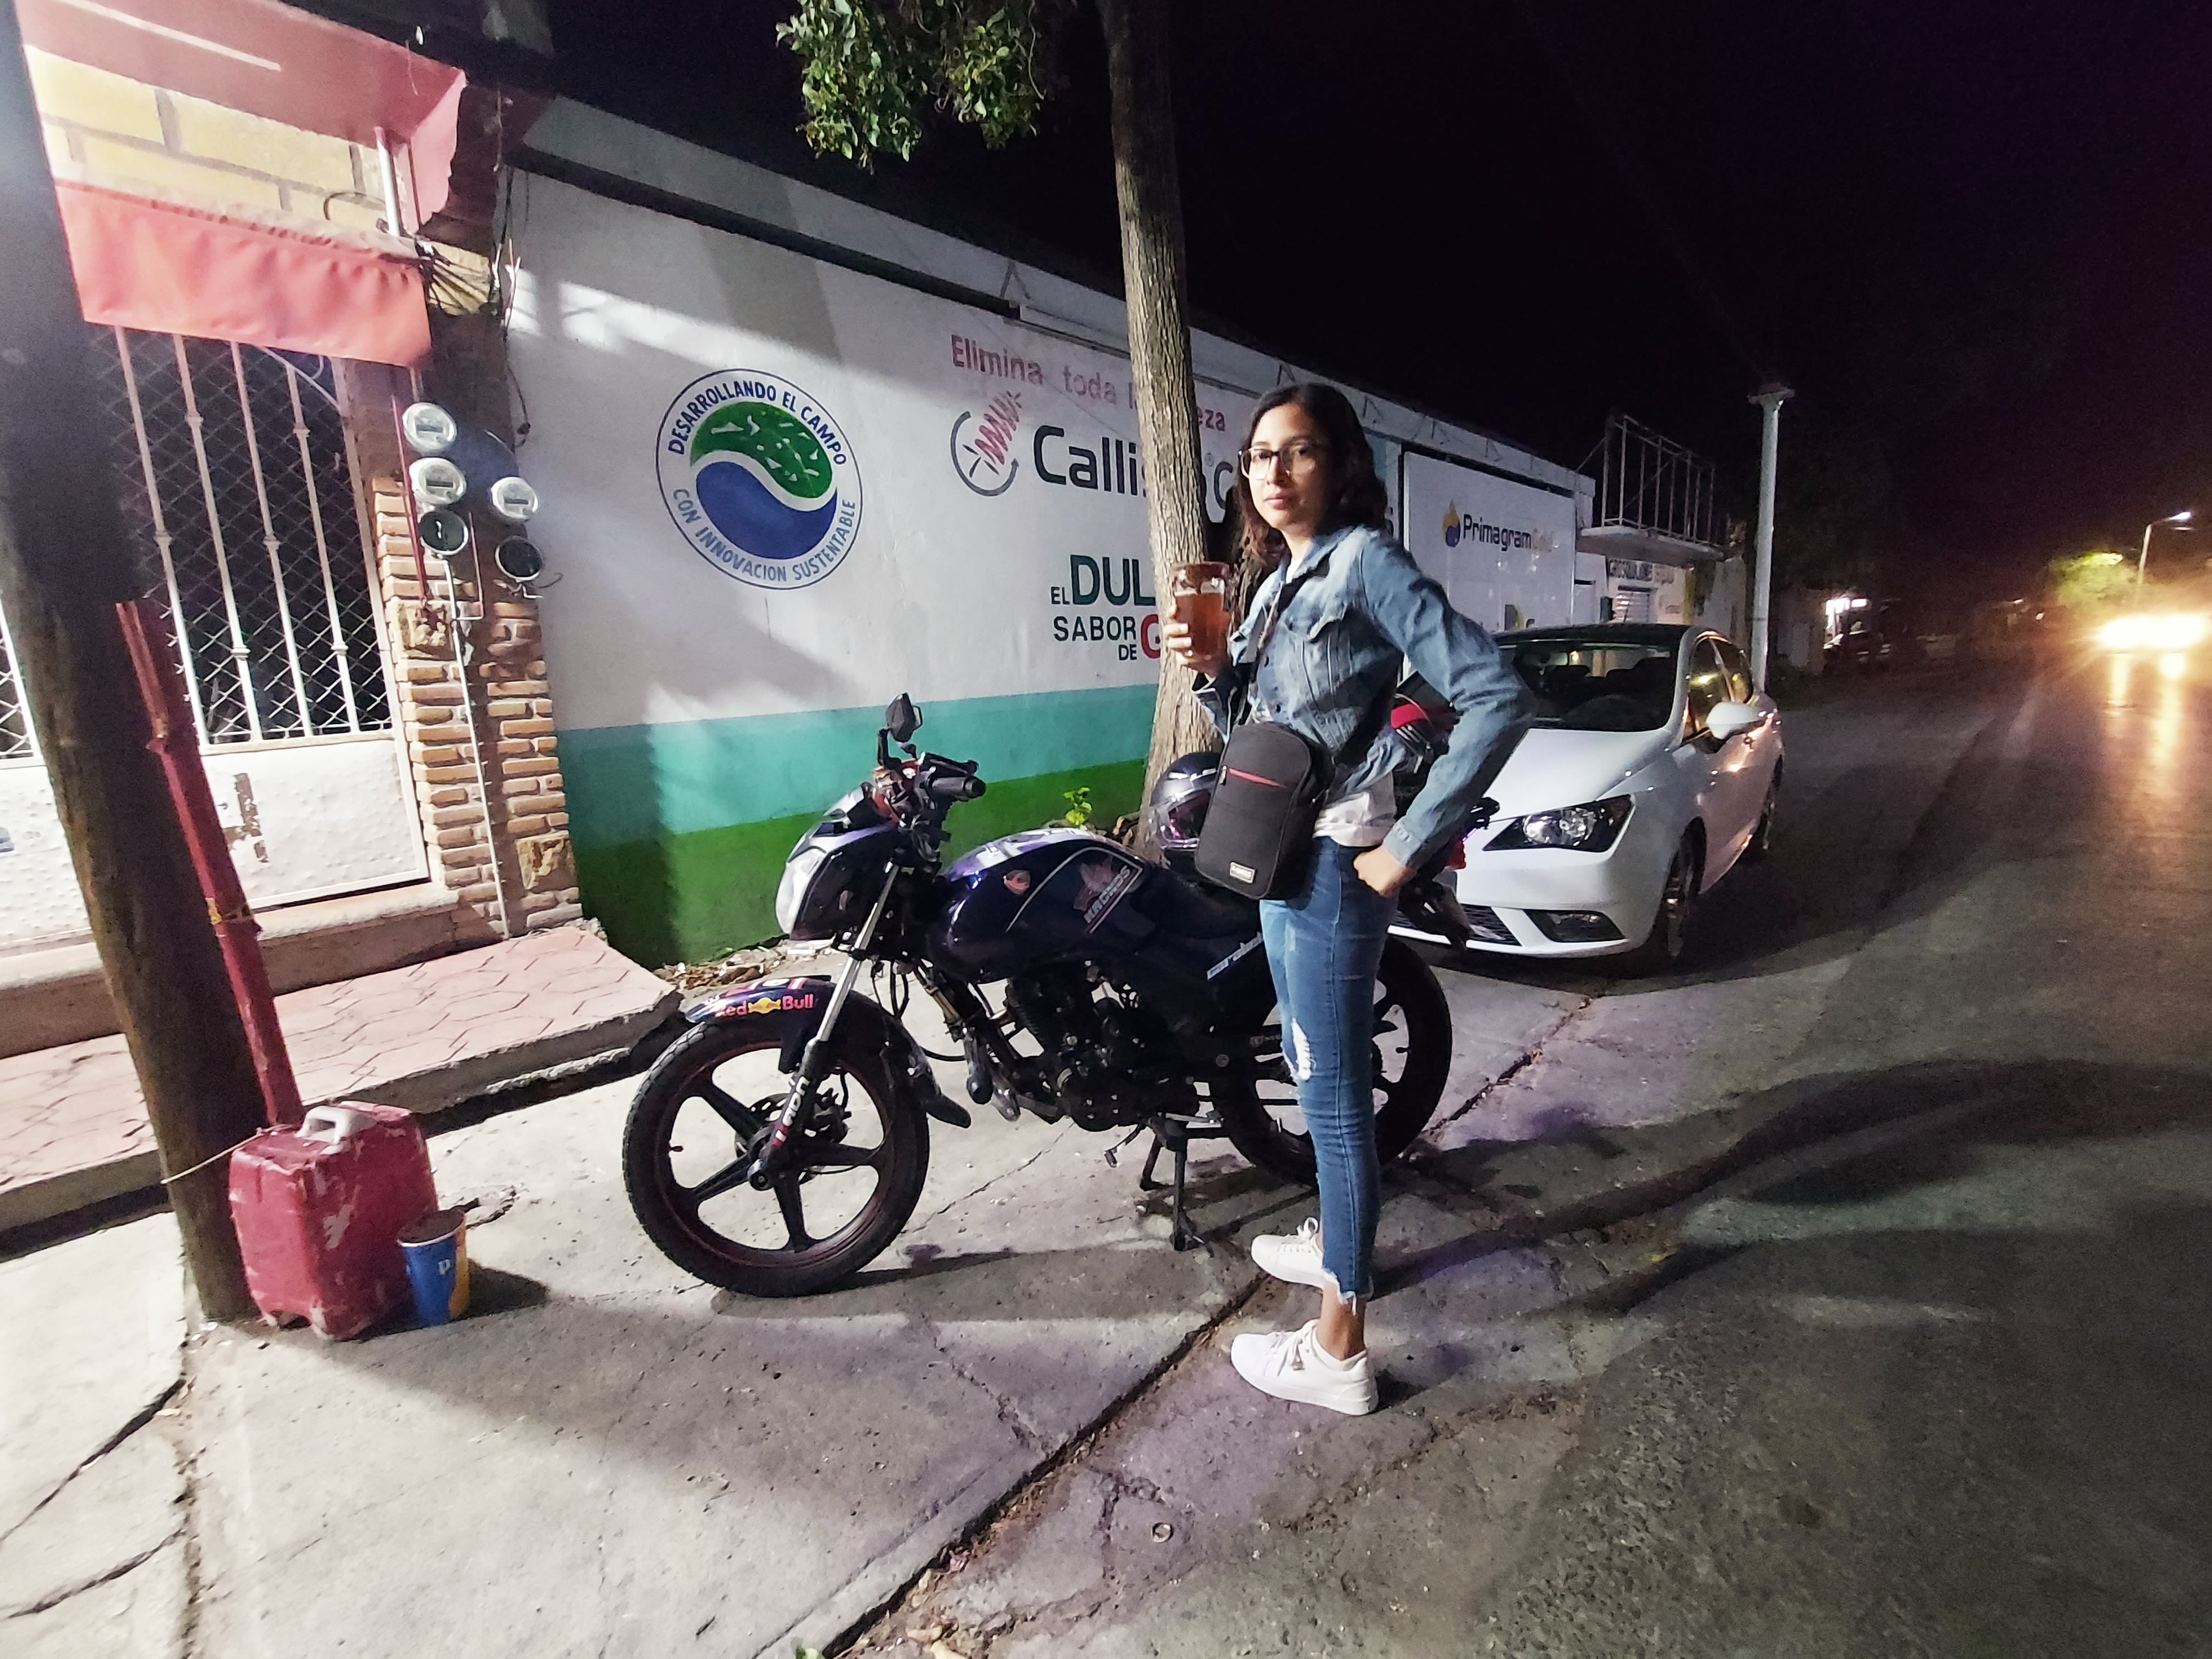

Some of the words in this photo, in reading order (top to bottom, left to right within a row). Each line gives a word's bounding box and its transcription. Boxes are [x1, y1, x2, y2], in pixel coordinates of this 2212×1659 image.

[951, 334, 1044, 385] Elimina
[1063, 365, 1117, 405] toda
[668, 380, 777, 455] DESARROLLANDO
[782, 390, 797, 413] EL
[800, 406, 847, 465] CAMPO
[673, 488, 701, 524] CON
[695, 526, 787, 582] INNOVACION
[792, 499, 856, 581] SUSTENTABLE
[1463, 513, 1532, 552] Primagram
[1051, 586, 1070, 606] EL
[1070, 554, 1156, 607] DUL
[1053, 615, 1137, 641] SABOR
[1118, 644, 1138, 661] DE
[782, 993, 814, 1010] Bull
